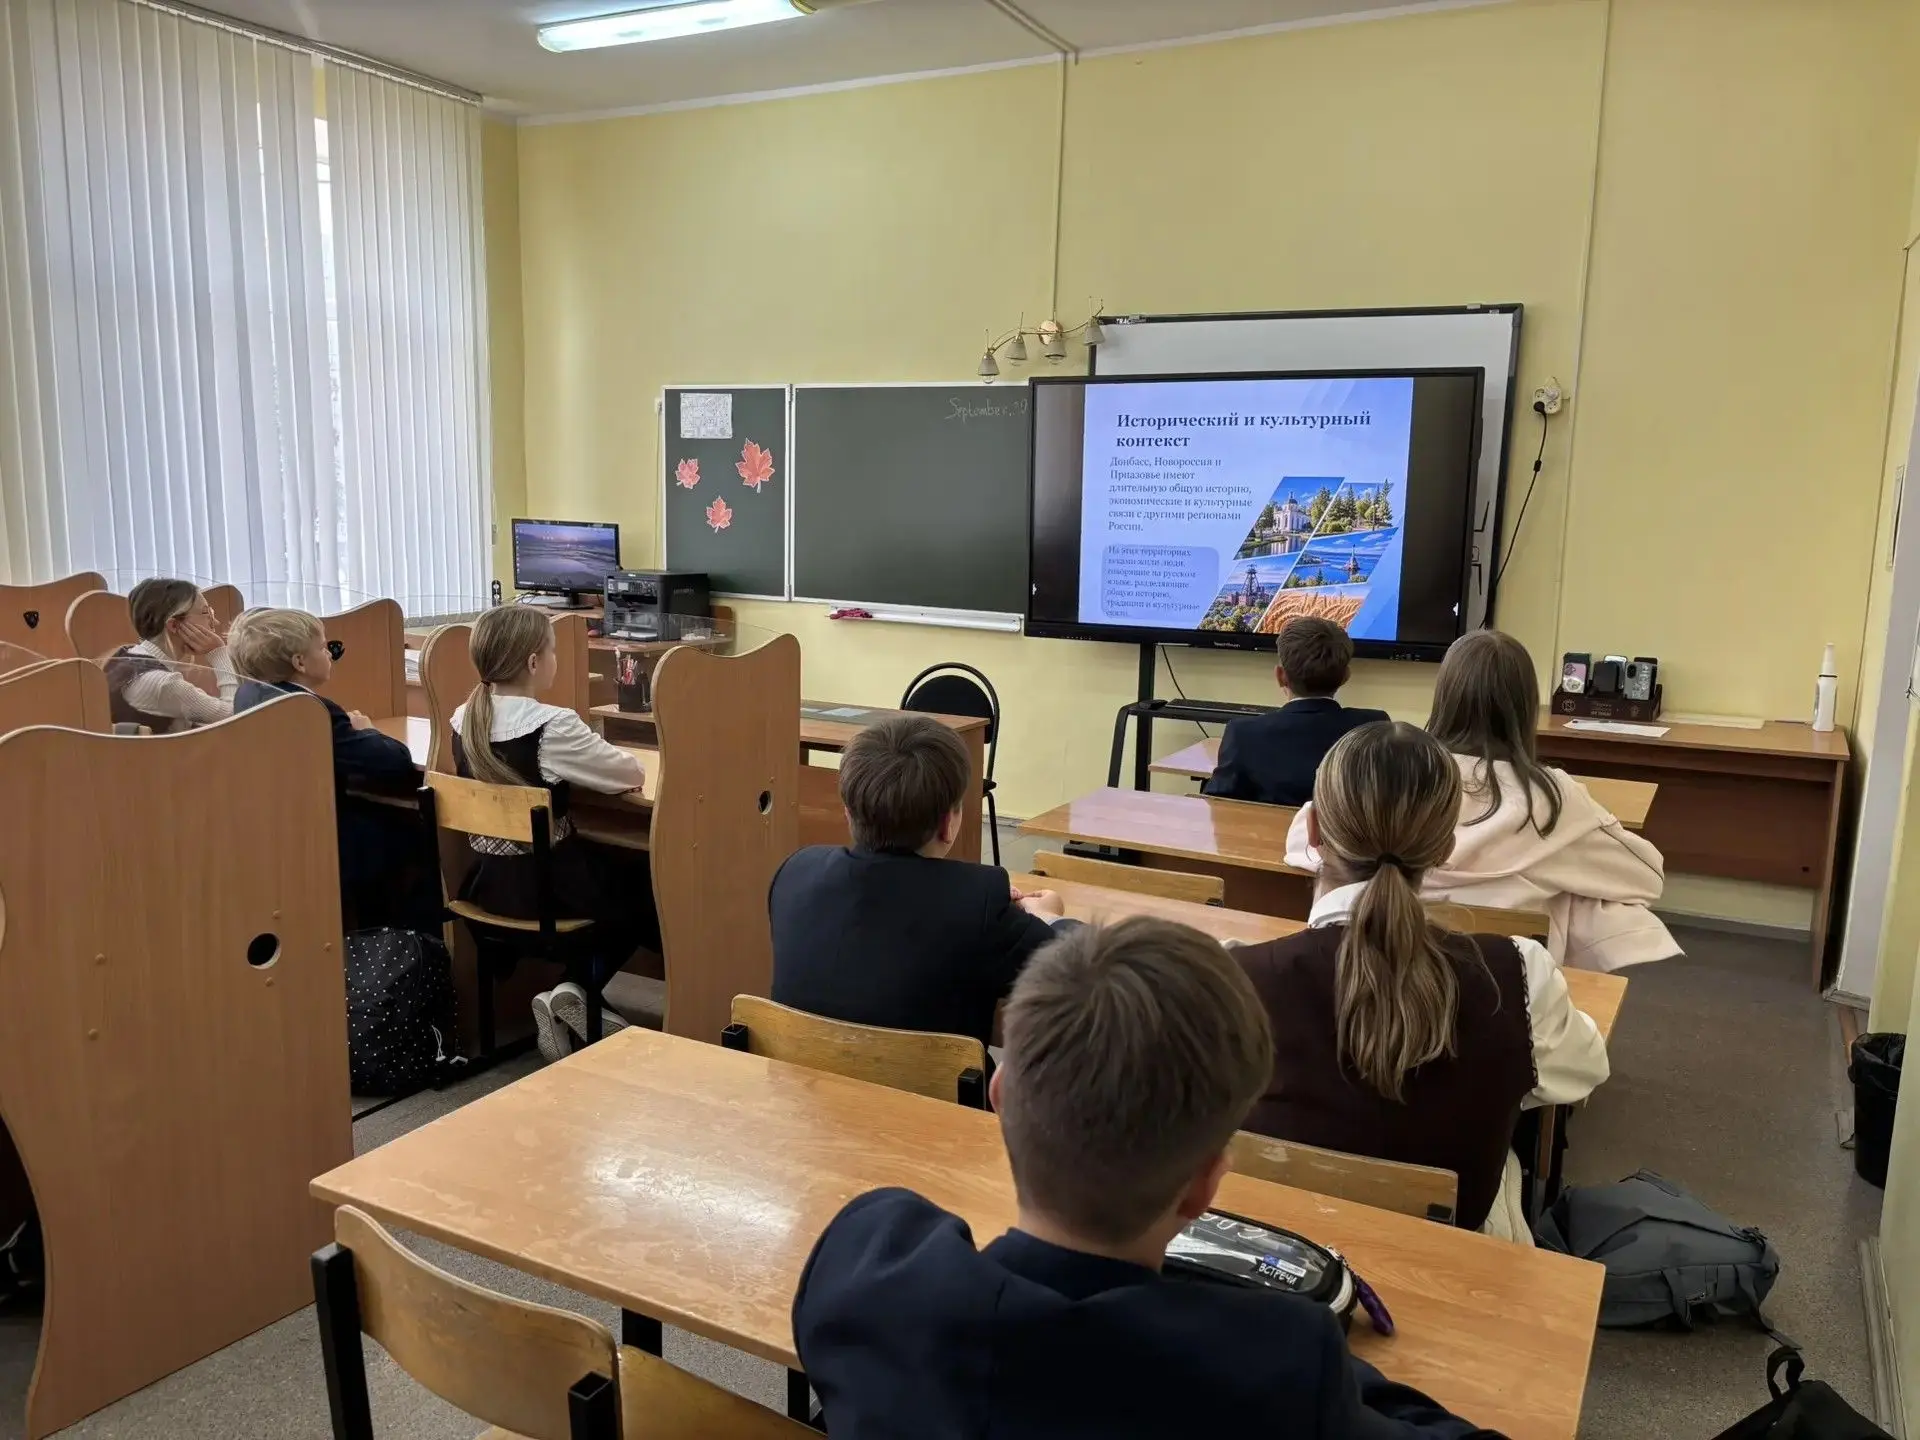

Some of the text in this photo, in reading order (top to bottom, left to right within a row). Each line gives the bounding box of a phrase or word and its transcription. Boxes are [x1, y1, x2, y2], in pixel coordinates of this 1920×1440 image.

[1117, 411, 1371, 430] Исторический и культурный
[1116, 435, 1190, 448] контекст
[1110, 456, 1222, 468] Донбасс, Новороссия и
[1110, 470, 1195, 481] Приазовье имеют
[1108, 484, 1252, 495] длительную общую историю,
[1109, 498, 1252, 508] экономические и культурные
[1143, 512, 1188, 520] другими
[1188, 512, 1241, 520] регионами
[1108, 522, 1144, 532] России.
[1106, 588, 1133, 597] общую
[1258, 1262, 1298, 1285] ВСТРЕЧИ
